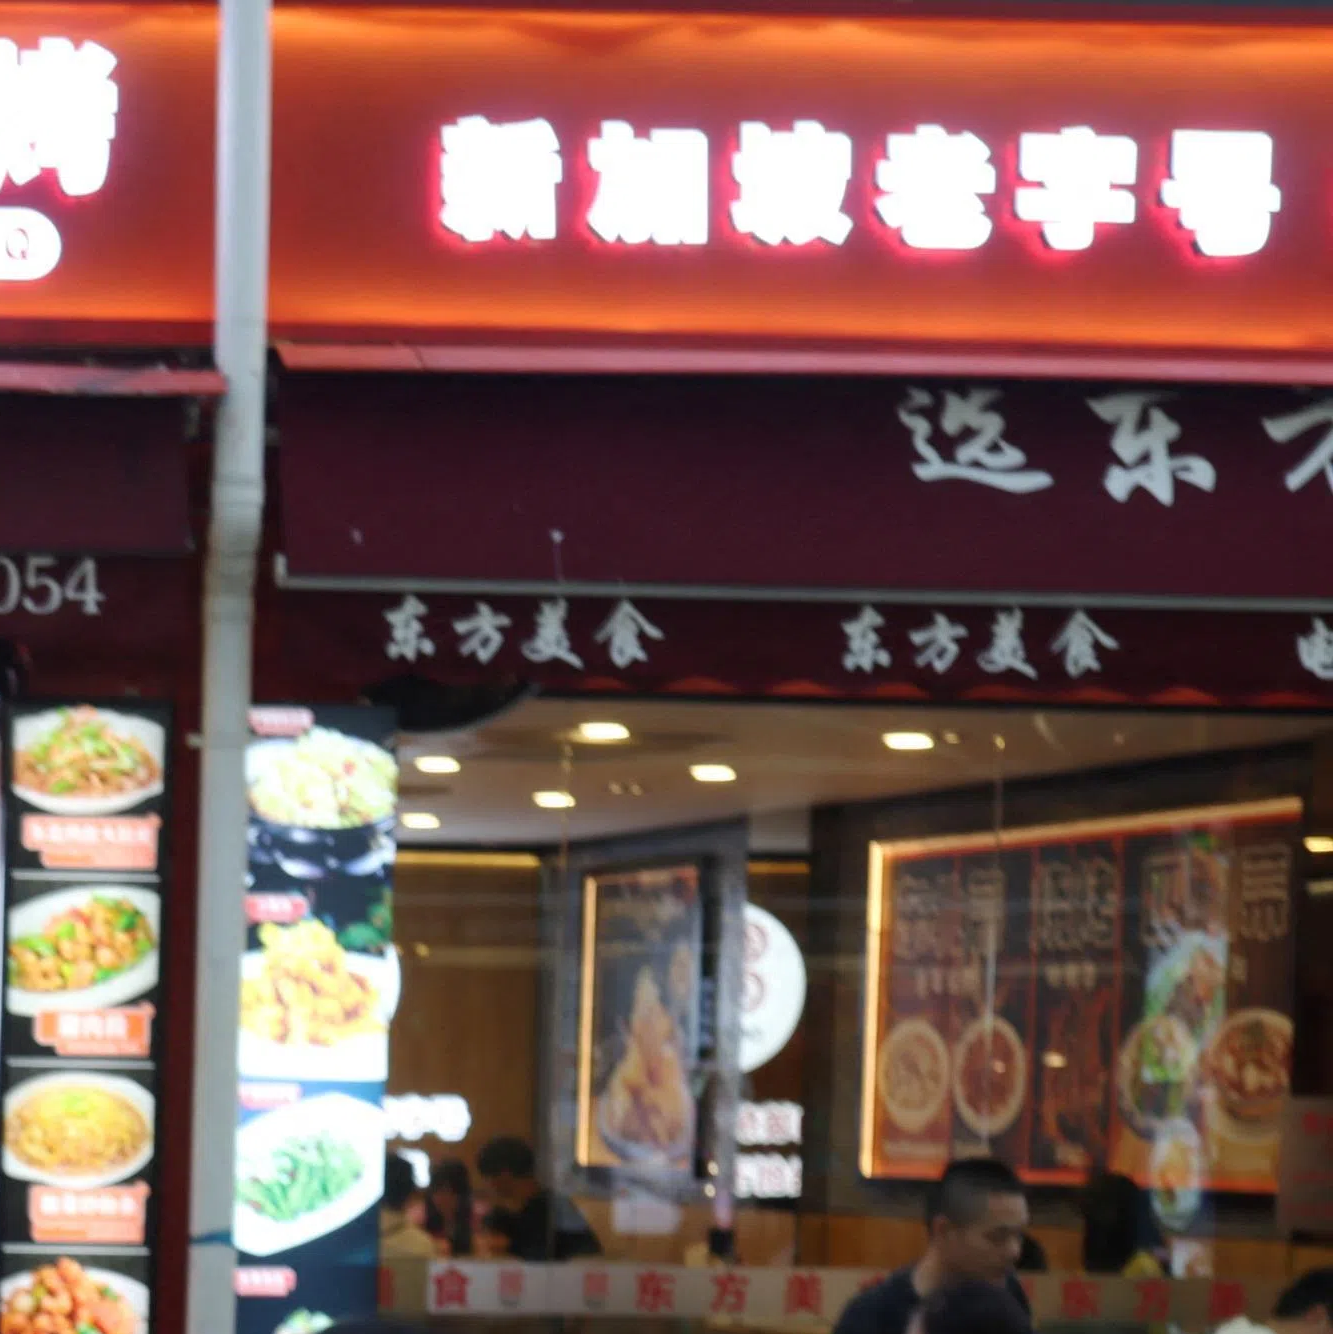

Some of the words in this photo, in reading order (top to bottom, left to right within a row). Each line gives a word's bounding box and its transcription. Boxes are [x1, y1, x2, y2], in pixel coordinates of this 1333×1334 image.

[383, 597, 664, 669] 东方美食
[841, 608, 1119, 679] 东方美食
